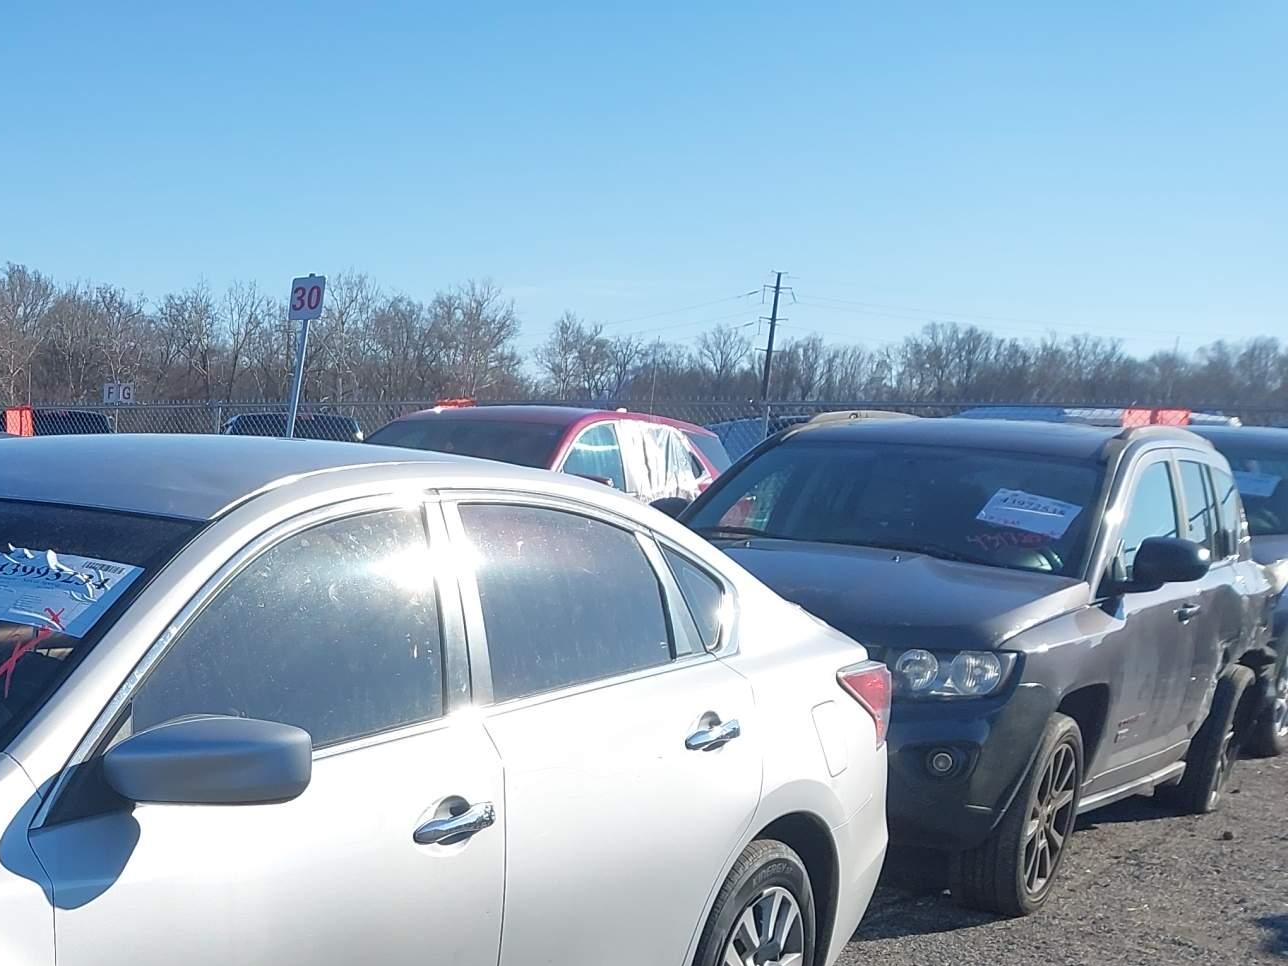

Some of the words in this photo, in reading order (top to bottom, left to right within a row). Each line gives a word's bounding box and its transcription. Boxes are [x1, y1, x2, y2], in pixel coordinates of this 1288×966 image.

[292, 285, 322, 311] 30
[107, 386, 114, 400] F
[122, 386, 131, 400] G
